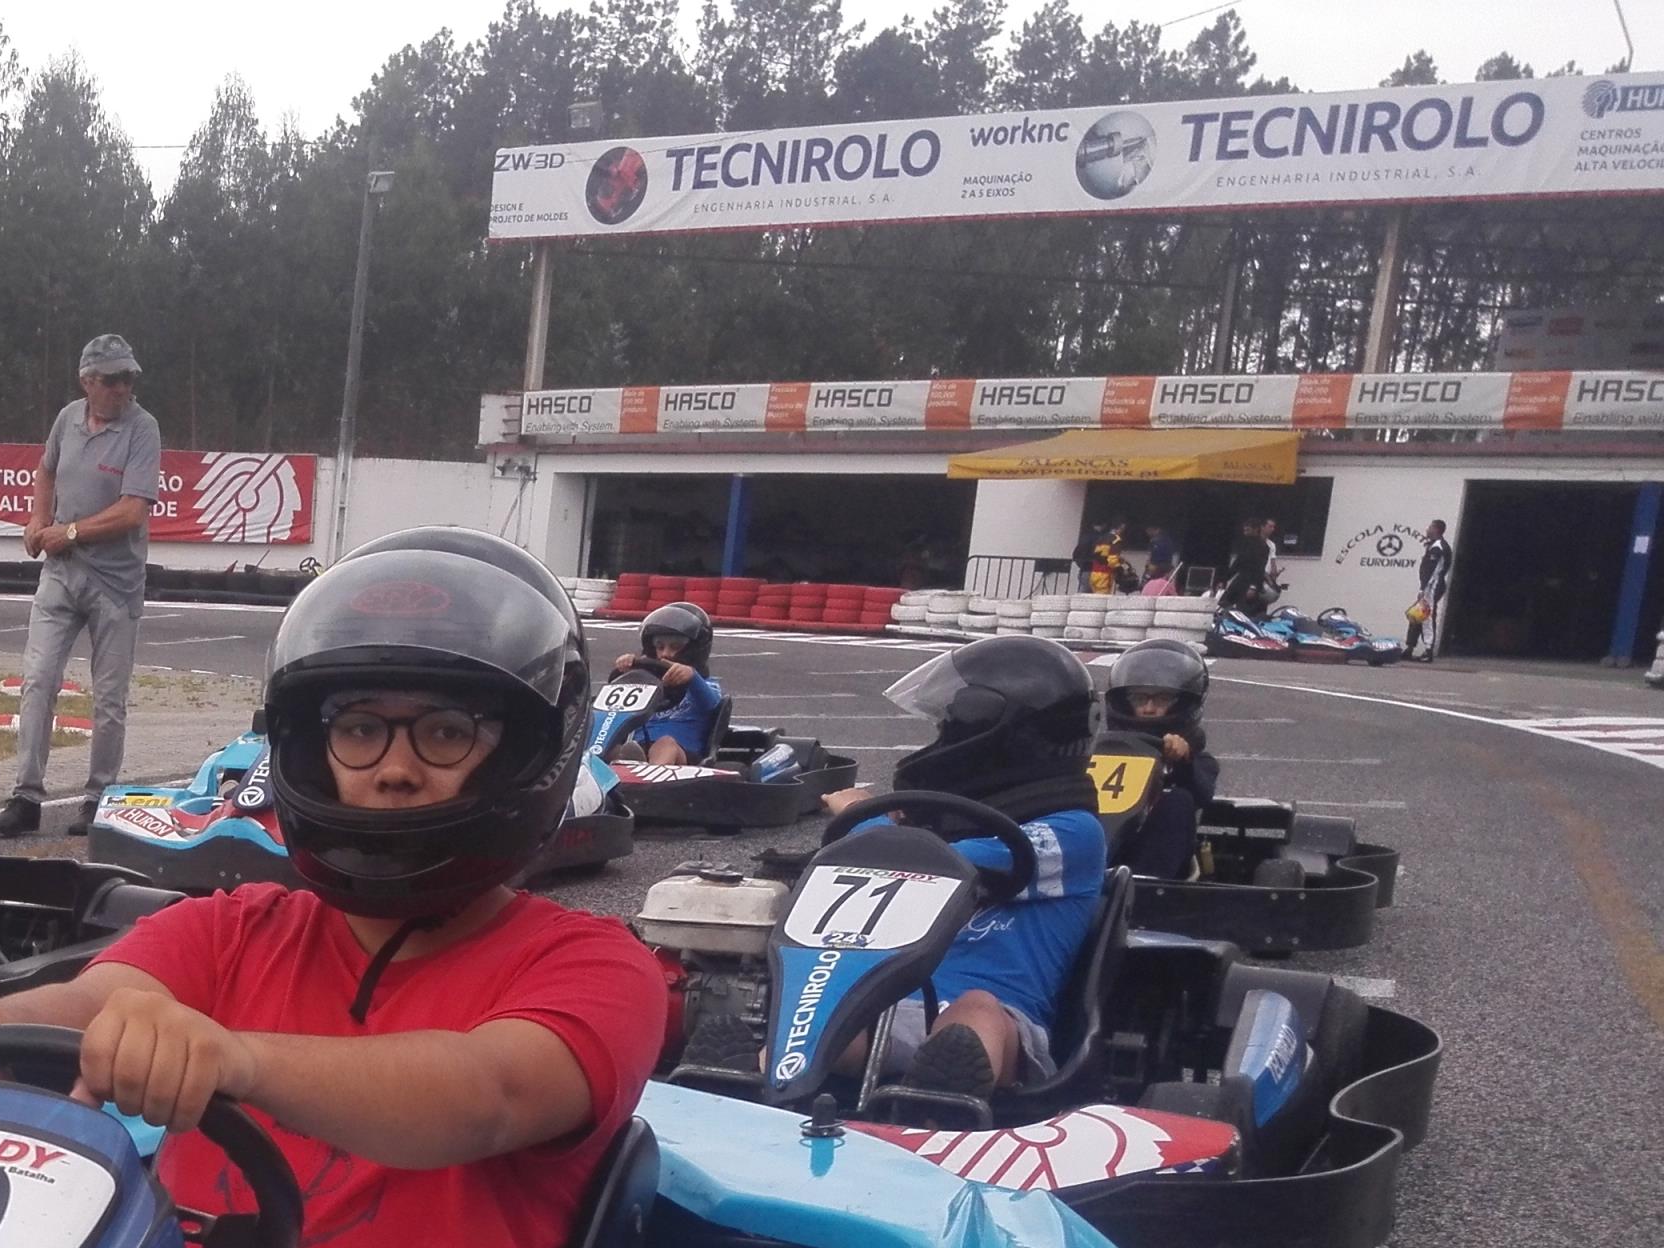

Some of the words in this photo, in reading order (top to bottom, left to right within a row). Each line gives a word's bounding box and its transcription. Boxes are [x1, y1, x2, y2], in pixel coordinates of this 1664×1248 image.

[969, 116, 1070, 147] worknc
[1181, 91, 1545, 162] TECNIROLO
[1580, 127, 1642, 141] CENTROS
[666, 129, 941, 191] TECNIROLO
[1574, 161, 1607, 171] ALTA
[1216, 172, 1321, 188] ENGENHARIA
[968, 189, 976, 199] A
[978, 189, 984, 198] 5
[986, 187, 1016, 198] EIXOS
[518, 203, 524, 211] E
[693, 199, 774, 213] ENGENHARIA
[524, 214, 534, 222] DE
[536, 212, 568, 221] MOLDES
[664, 391, 736, 411] HASCO
[815, 388, 893, 408] HASCO
[979, 386, 1065, 406] HASCO
[1160, 383, 1254, 404] HASCO
[1358, 381, 1462, 403] HASCO
[527, 395, 592, 415] HASCO
[1336, 524, 1384, 565] ESCOLA
[1394, 523, 1431, 549] KART
[1359, 557, 1417, 569] EUROINDY
[605, 687, 643, 708] 66
[124, 808, 173, 835] HURON
[812, 874, 908, 936] 71
[786, 951, 842, 1053] TECNIROLO
[8, 1167, 57, 1184] Batalha
